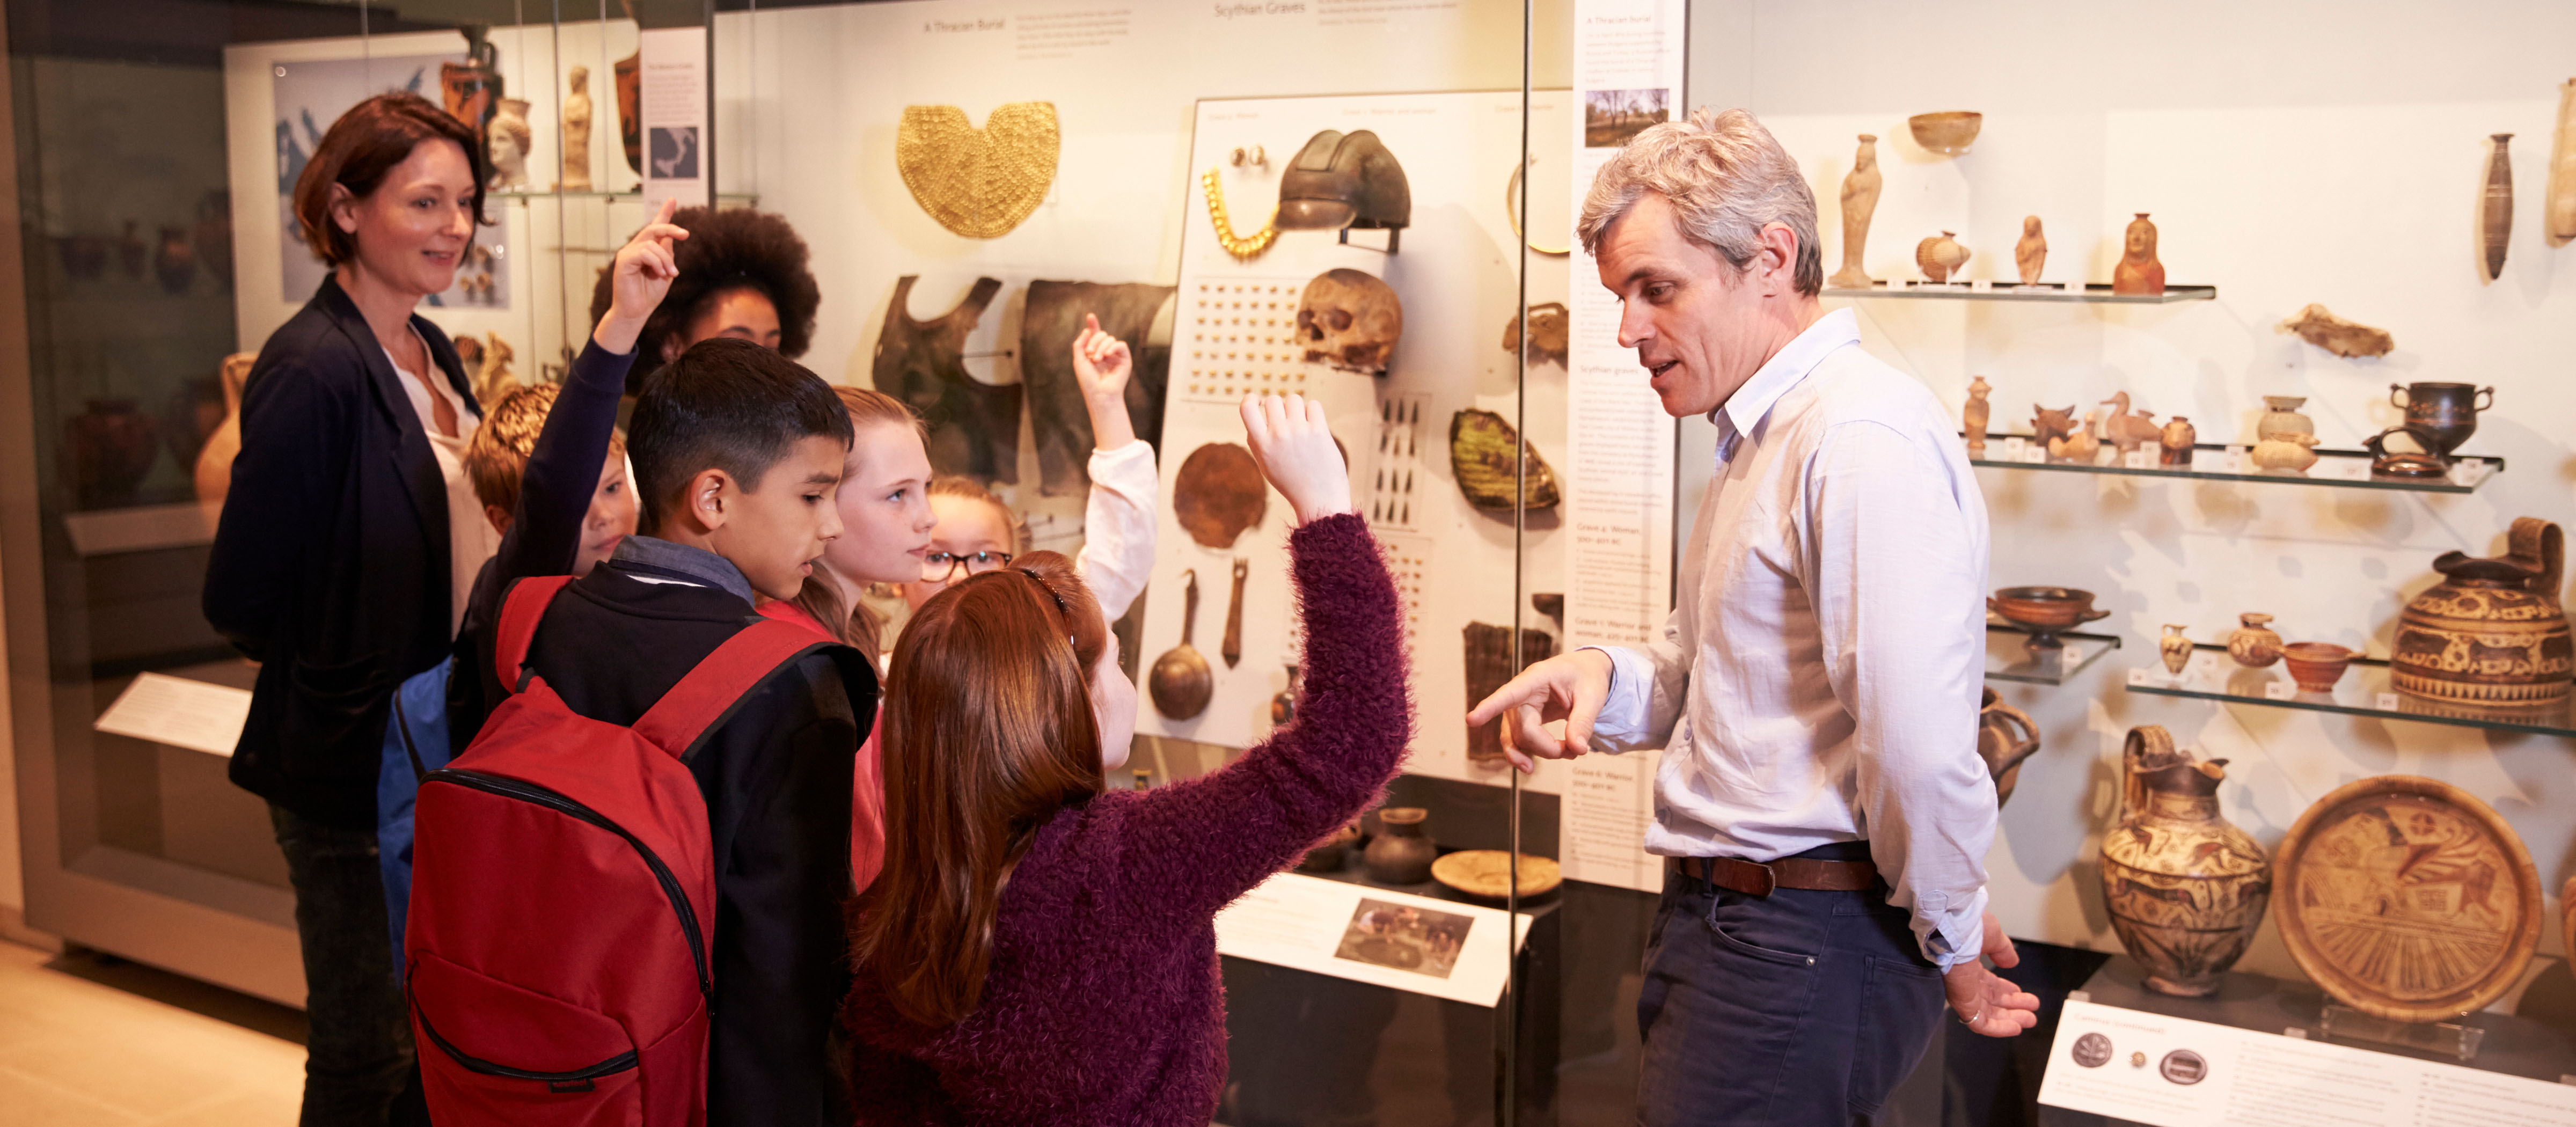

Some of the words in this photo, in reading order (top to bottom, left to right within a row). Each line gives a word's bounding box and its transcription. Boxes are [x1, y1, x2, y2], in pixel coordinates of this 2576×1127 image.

[1266, 2, 1306, 15] Graves
[1580, 365, 1612, 378] Scythian
[1614, 368, 1638, 377] graves
[1577, 523, 1599, 532] Grave
[1575, 617, 1597, 626] Grave
[1607, 620, 1635, 630] Warrior
[1572, 767, 1594, 777] Grave
